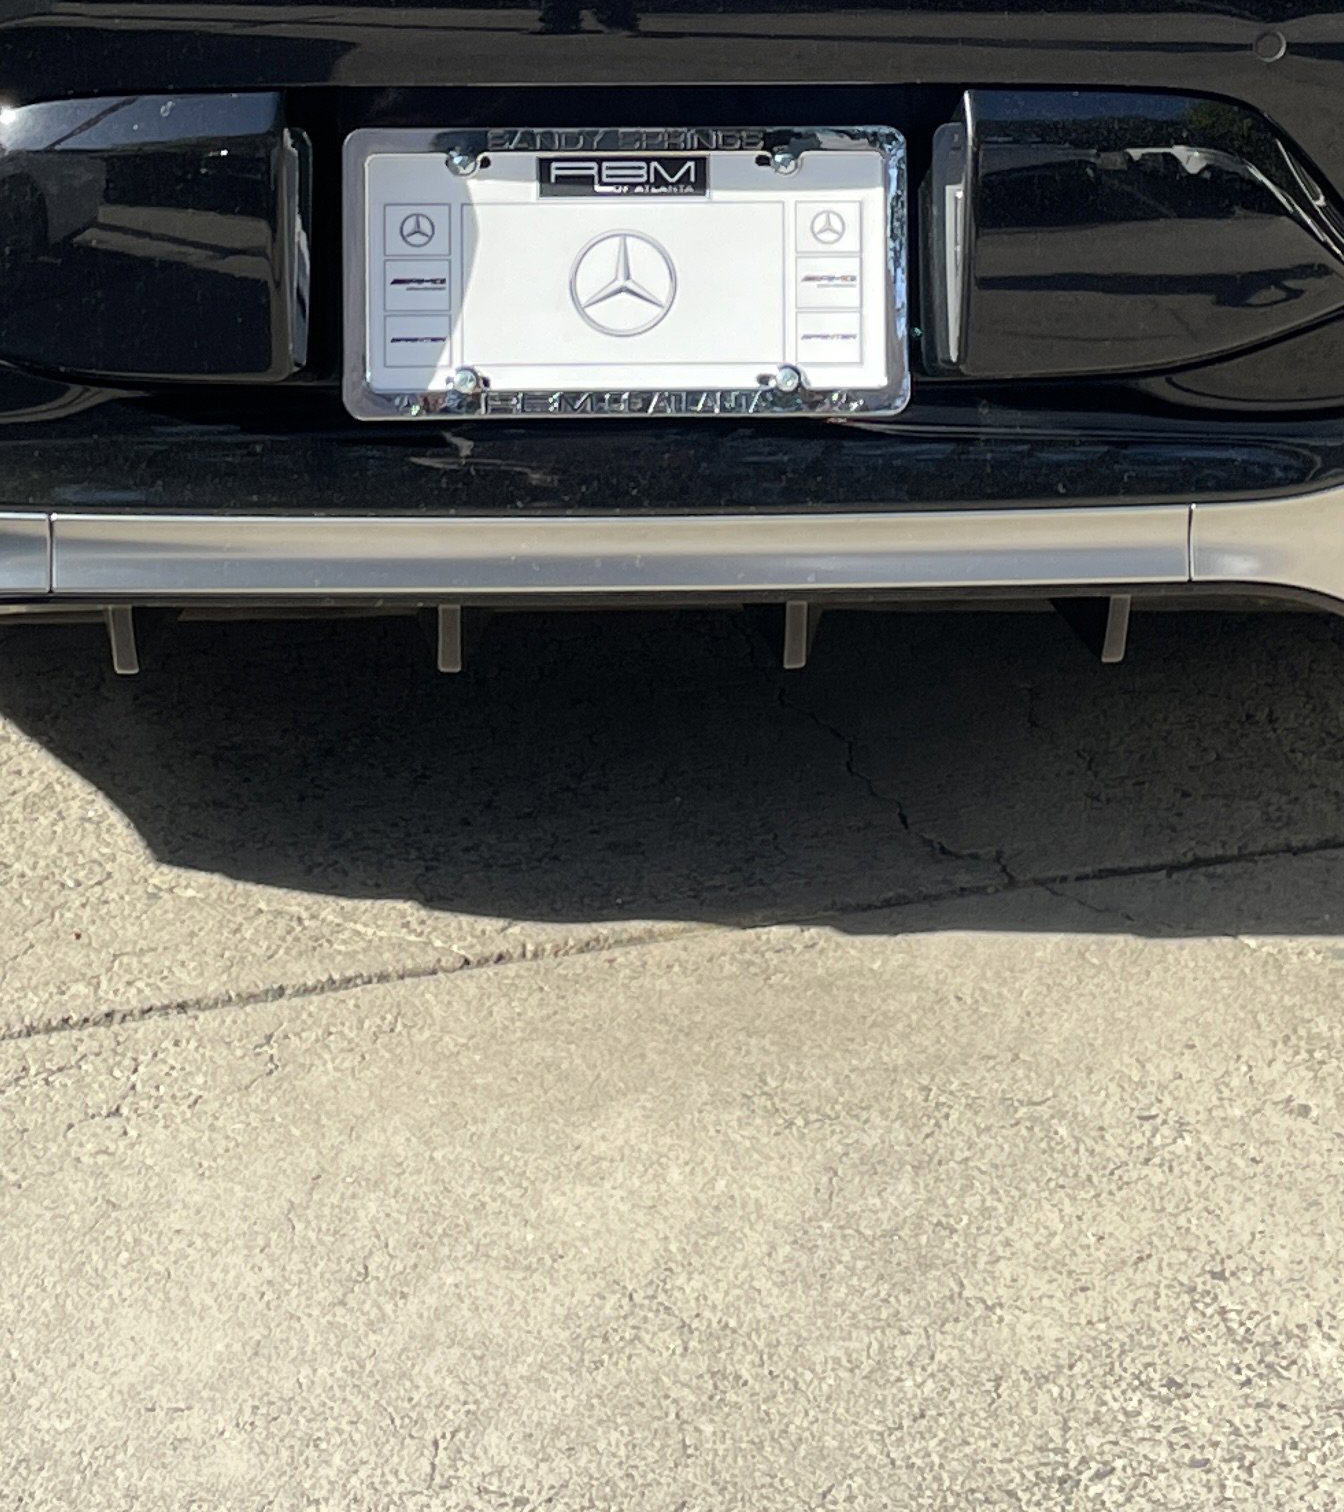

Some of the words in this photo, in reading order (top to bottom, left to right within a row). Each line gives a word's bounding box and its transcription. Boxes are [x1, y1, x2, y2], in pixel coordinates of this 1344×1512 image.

[487, 127, 605, 151] SANDY
[617, 126, 765, 151] SPRINGS
[550, 160, 696, 186] RBM
